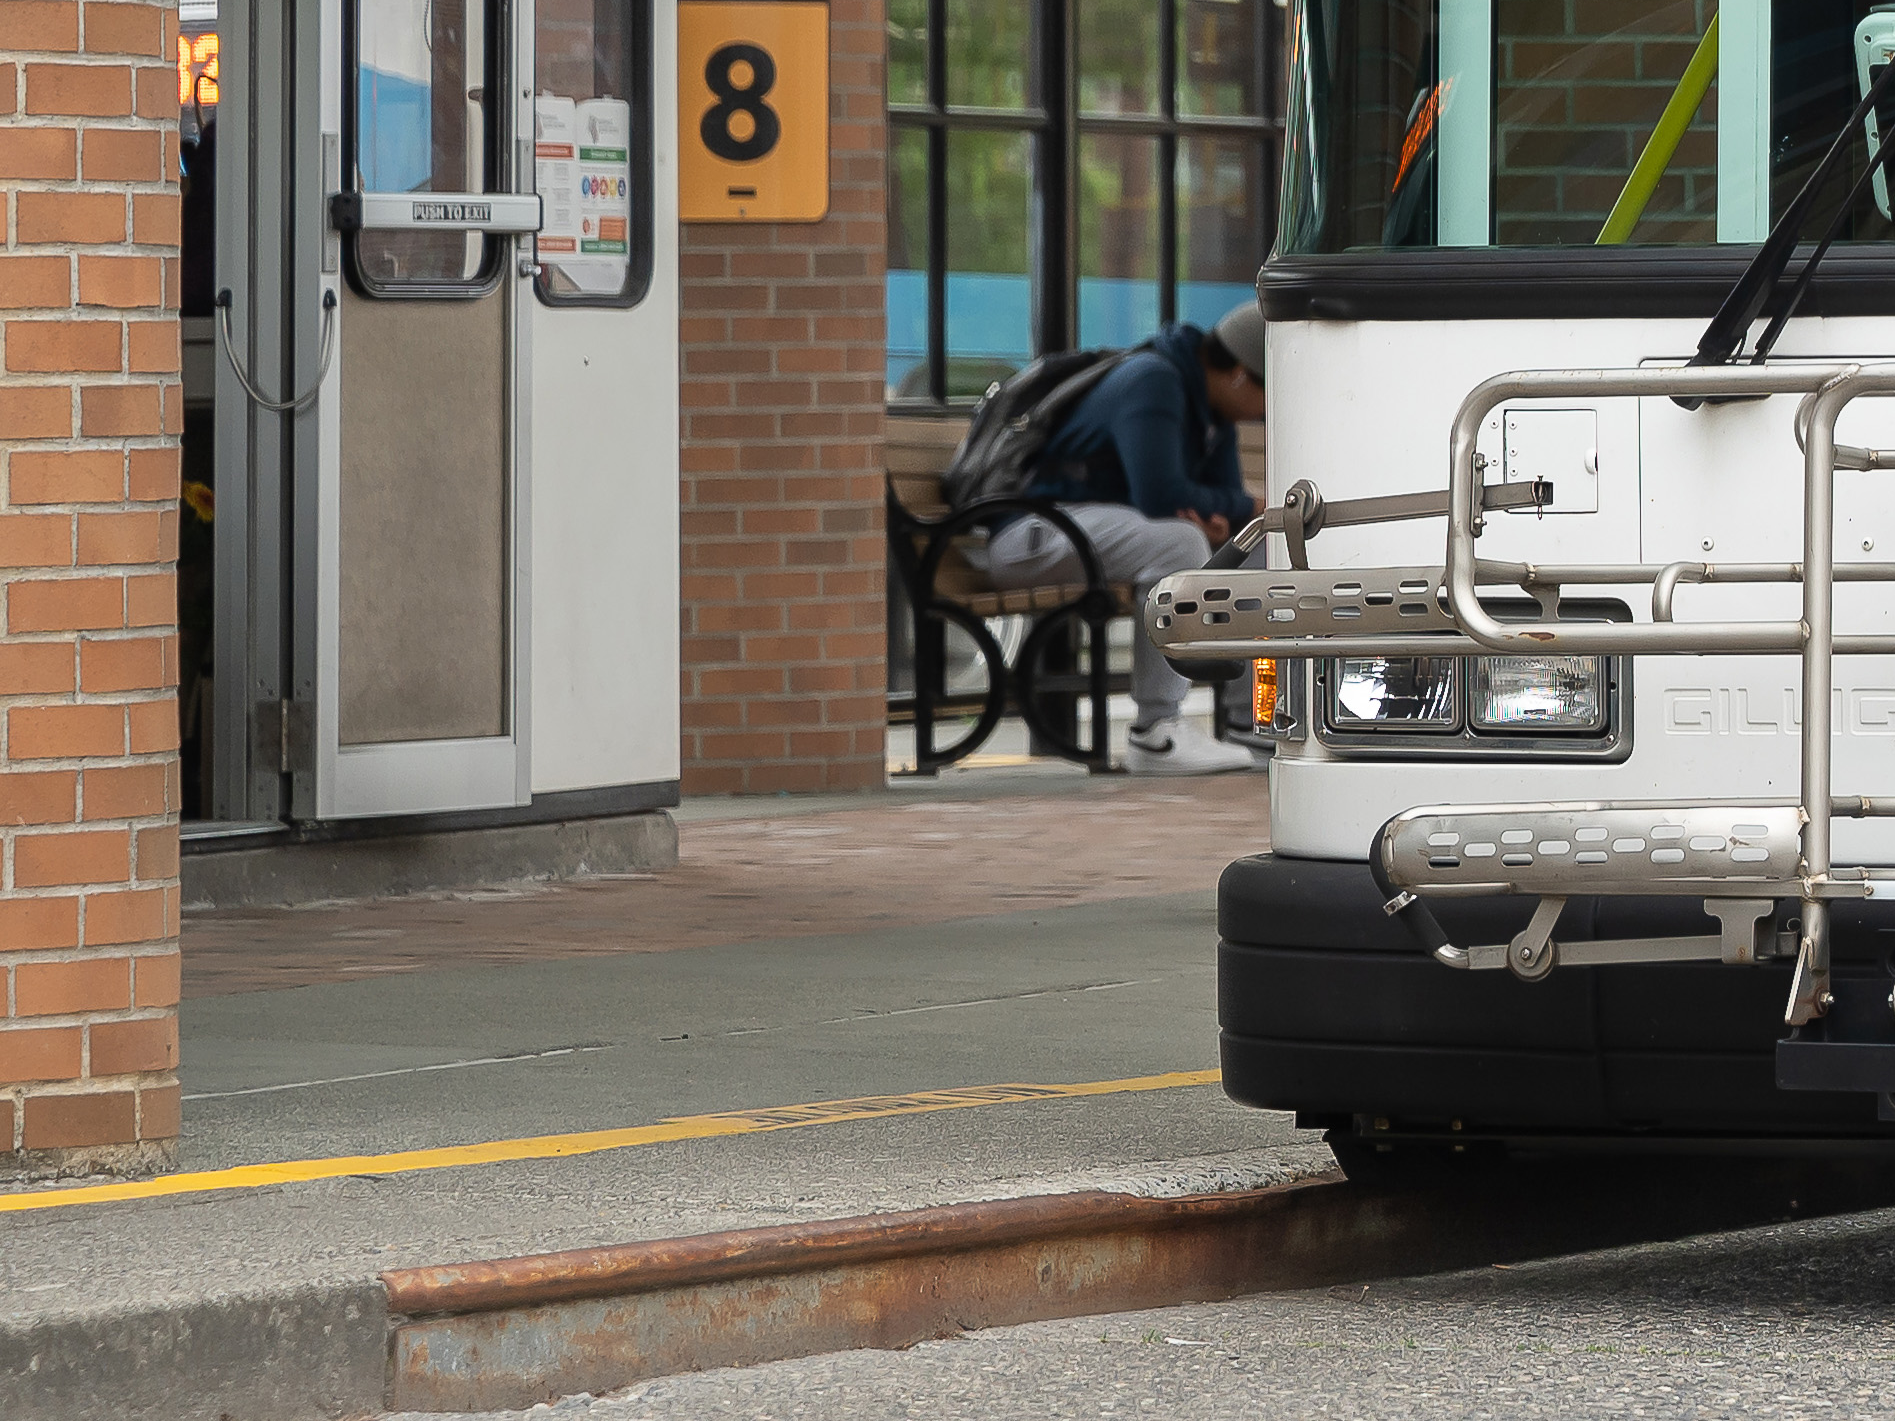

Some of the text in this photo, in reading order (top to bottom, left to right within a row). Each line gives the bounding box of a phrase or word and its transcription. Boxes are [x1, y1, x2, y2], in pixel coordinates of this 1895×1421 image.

[699, 43, 781, 163] 8
[415, 203, 444, 220] PUSH
[446, 203, 462, 220] TO
